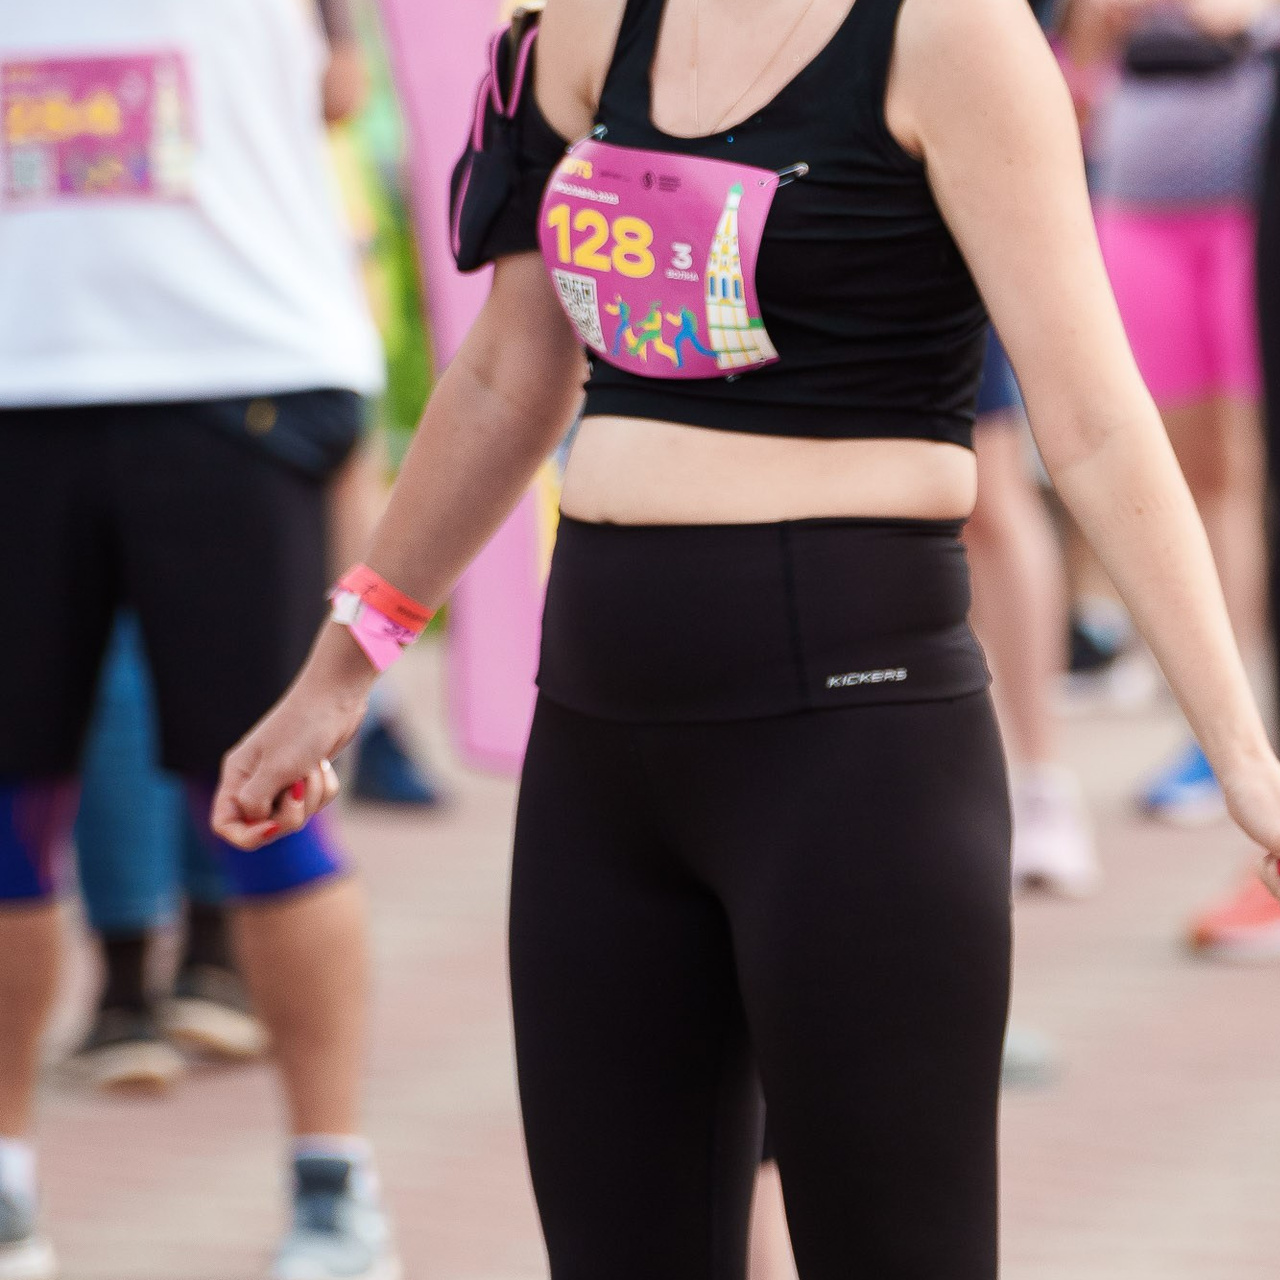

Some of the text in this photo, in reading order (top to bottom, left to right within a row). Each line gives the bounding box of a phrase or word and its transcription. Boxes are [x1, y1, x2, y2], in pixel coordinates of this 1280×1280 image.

[548, 204, 655, 279] 128
[671, 242, 693, 271] 3
[826, 667, 908, 689] KICKERS
